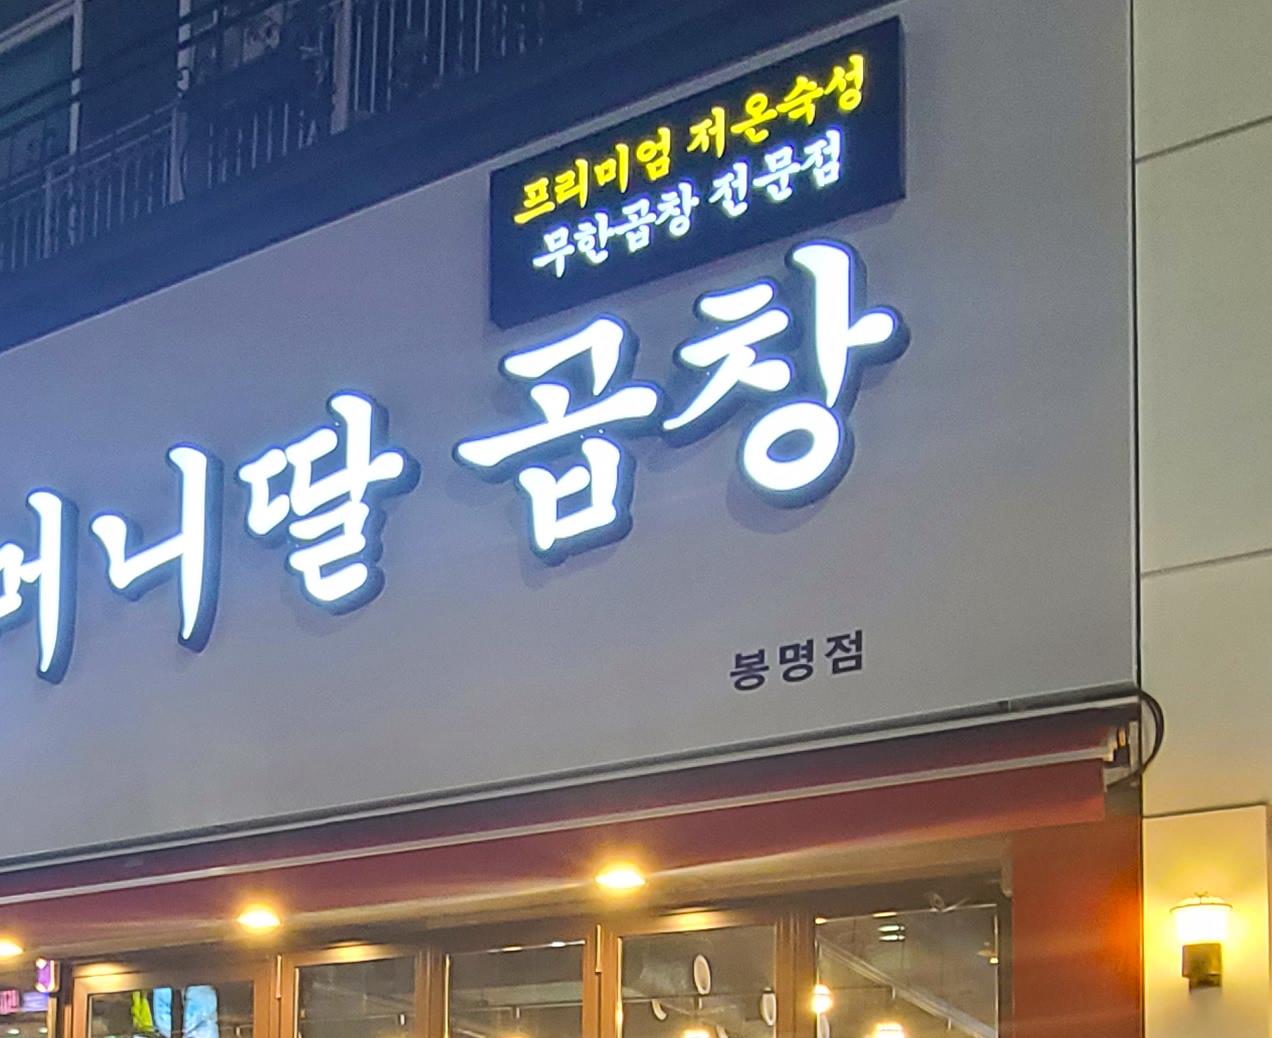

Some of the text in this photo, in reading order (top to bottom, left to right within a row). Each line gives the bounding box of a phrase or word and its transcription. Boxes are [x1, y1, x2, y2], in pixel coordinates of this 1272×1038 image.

[514, 54, 865, 224] 프리미엄 저온숙성
[532, 128, 843, 278] 무한곱창 전문점
[456, 243, 896, 550] 곱창
[730, 629, 862, 691] 봉명점
